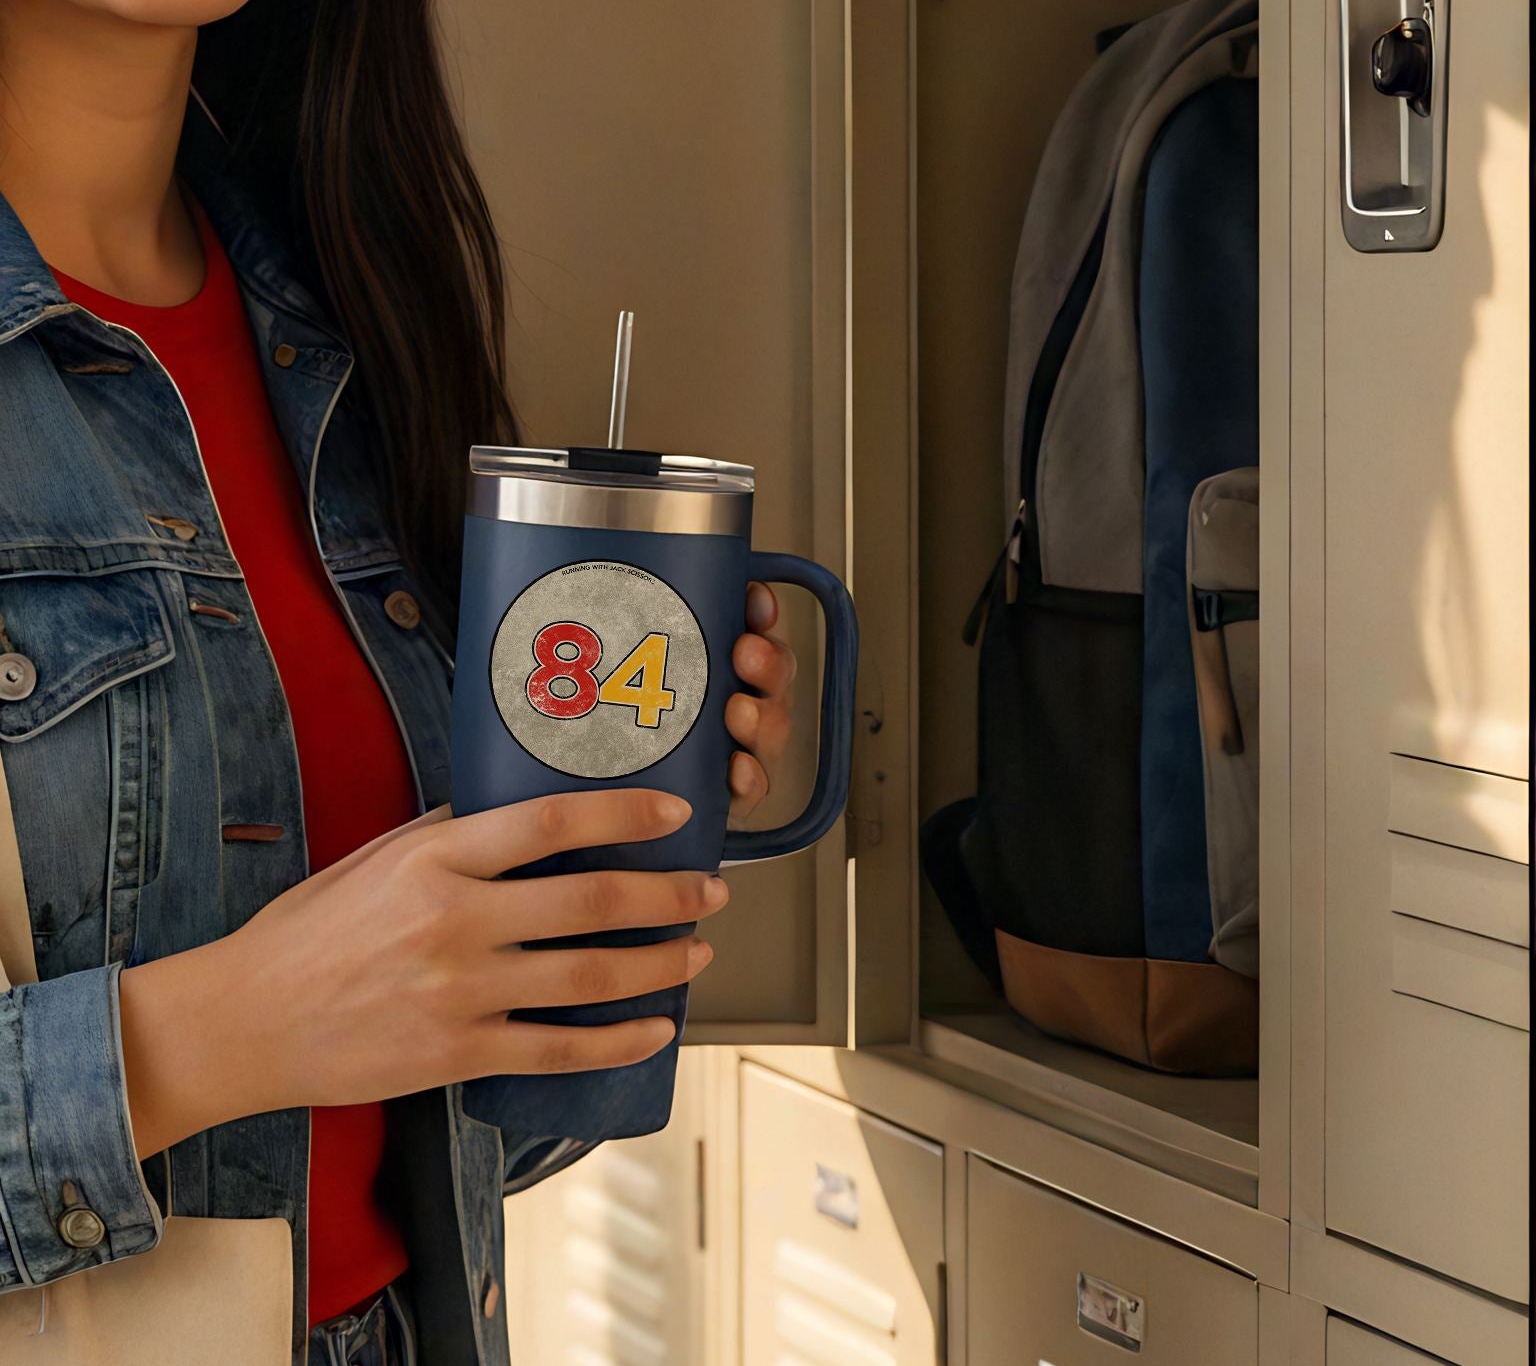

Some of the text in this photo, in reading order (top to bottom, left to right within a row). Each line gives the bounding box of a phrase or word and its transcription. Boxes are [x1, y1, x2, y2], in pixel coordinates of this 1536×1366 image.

[561, 564, 590, 576] RUNNING
[610, 565, 626, 573] JACK
[525, 620, 676, 729] 84
